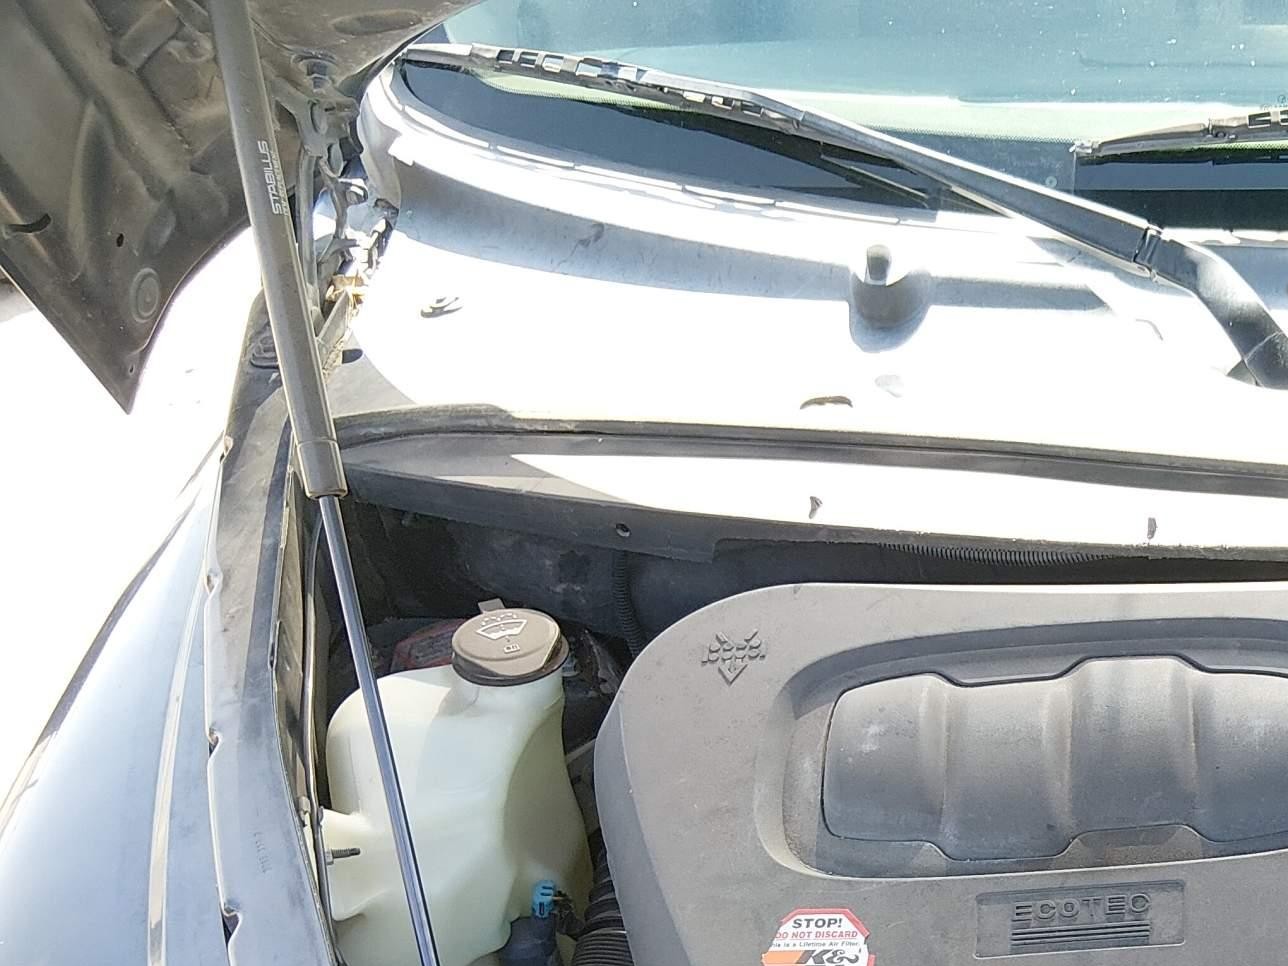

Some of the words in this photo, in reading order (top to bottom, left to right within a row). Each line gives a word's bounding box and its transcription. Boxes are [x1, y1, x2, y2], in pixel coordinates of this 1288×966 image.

[258, 140, 282, 215] STABILUS
[1011, 892, 1152, 922] ECOTEC
[792, 918, 842, 929] STOP!
[775, 931, 788, 939] DO
[814, 930, 858, 938] DISCARD
